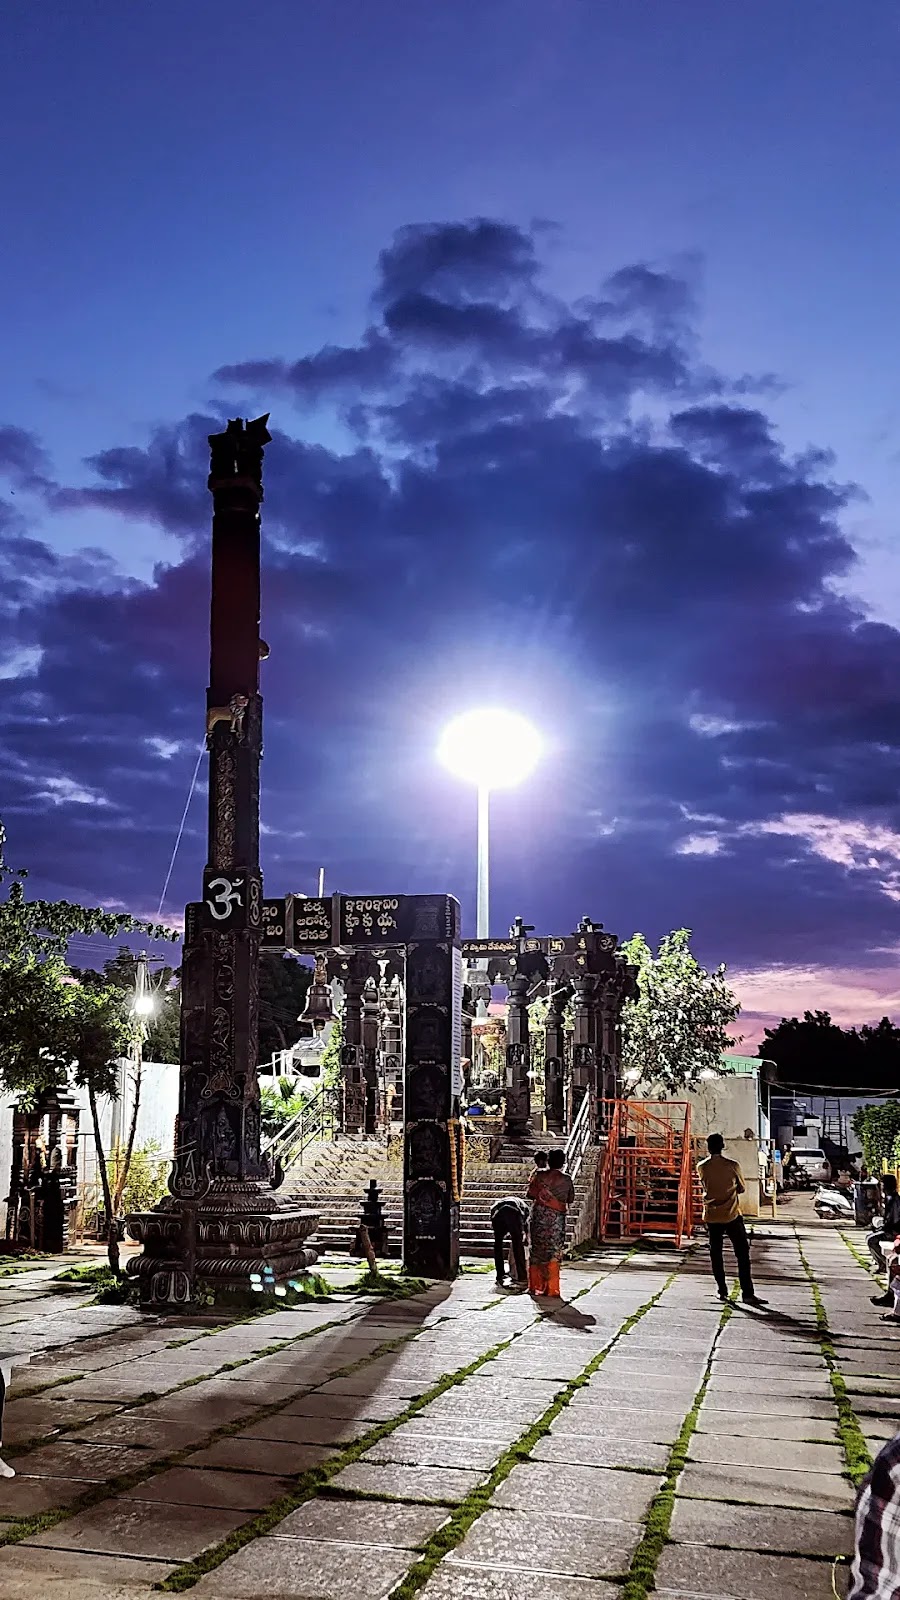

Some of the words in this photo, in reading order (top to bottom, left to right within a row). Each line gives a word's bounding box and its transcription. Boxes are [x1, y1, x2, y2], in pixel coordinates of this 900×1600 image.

[303, 902, 325, 915] సర్వ
[296, 915, 332, 929] ఆరోగ్య
[299, 929, 328, 940] దేవత
